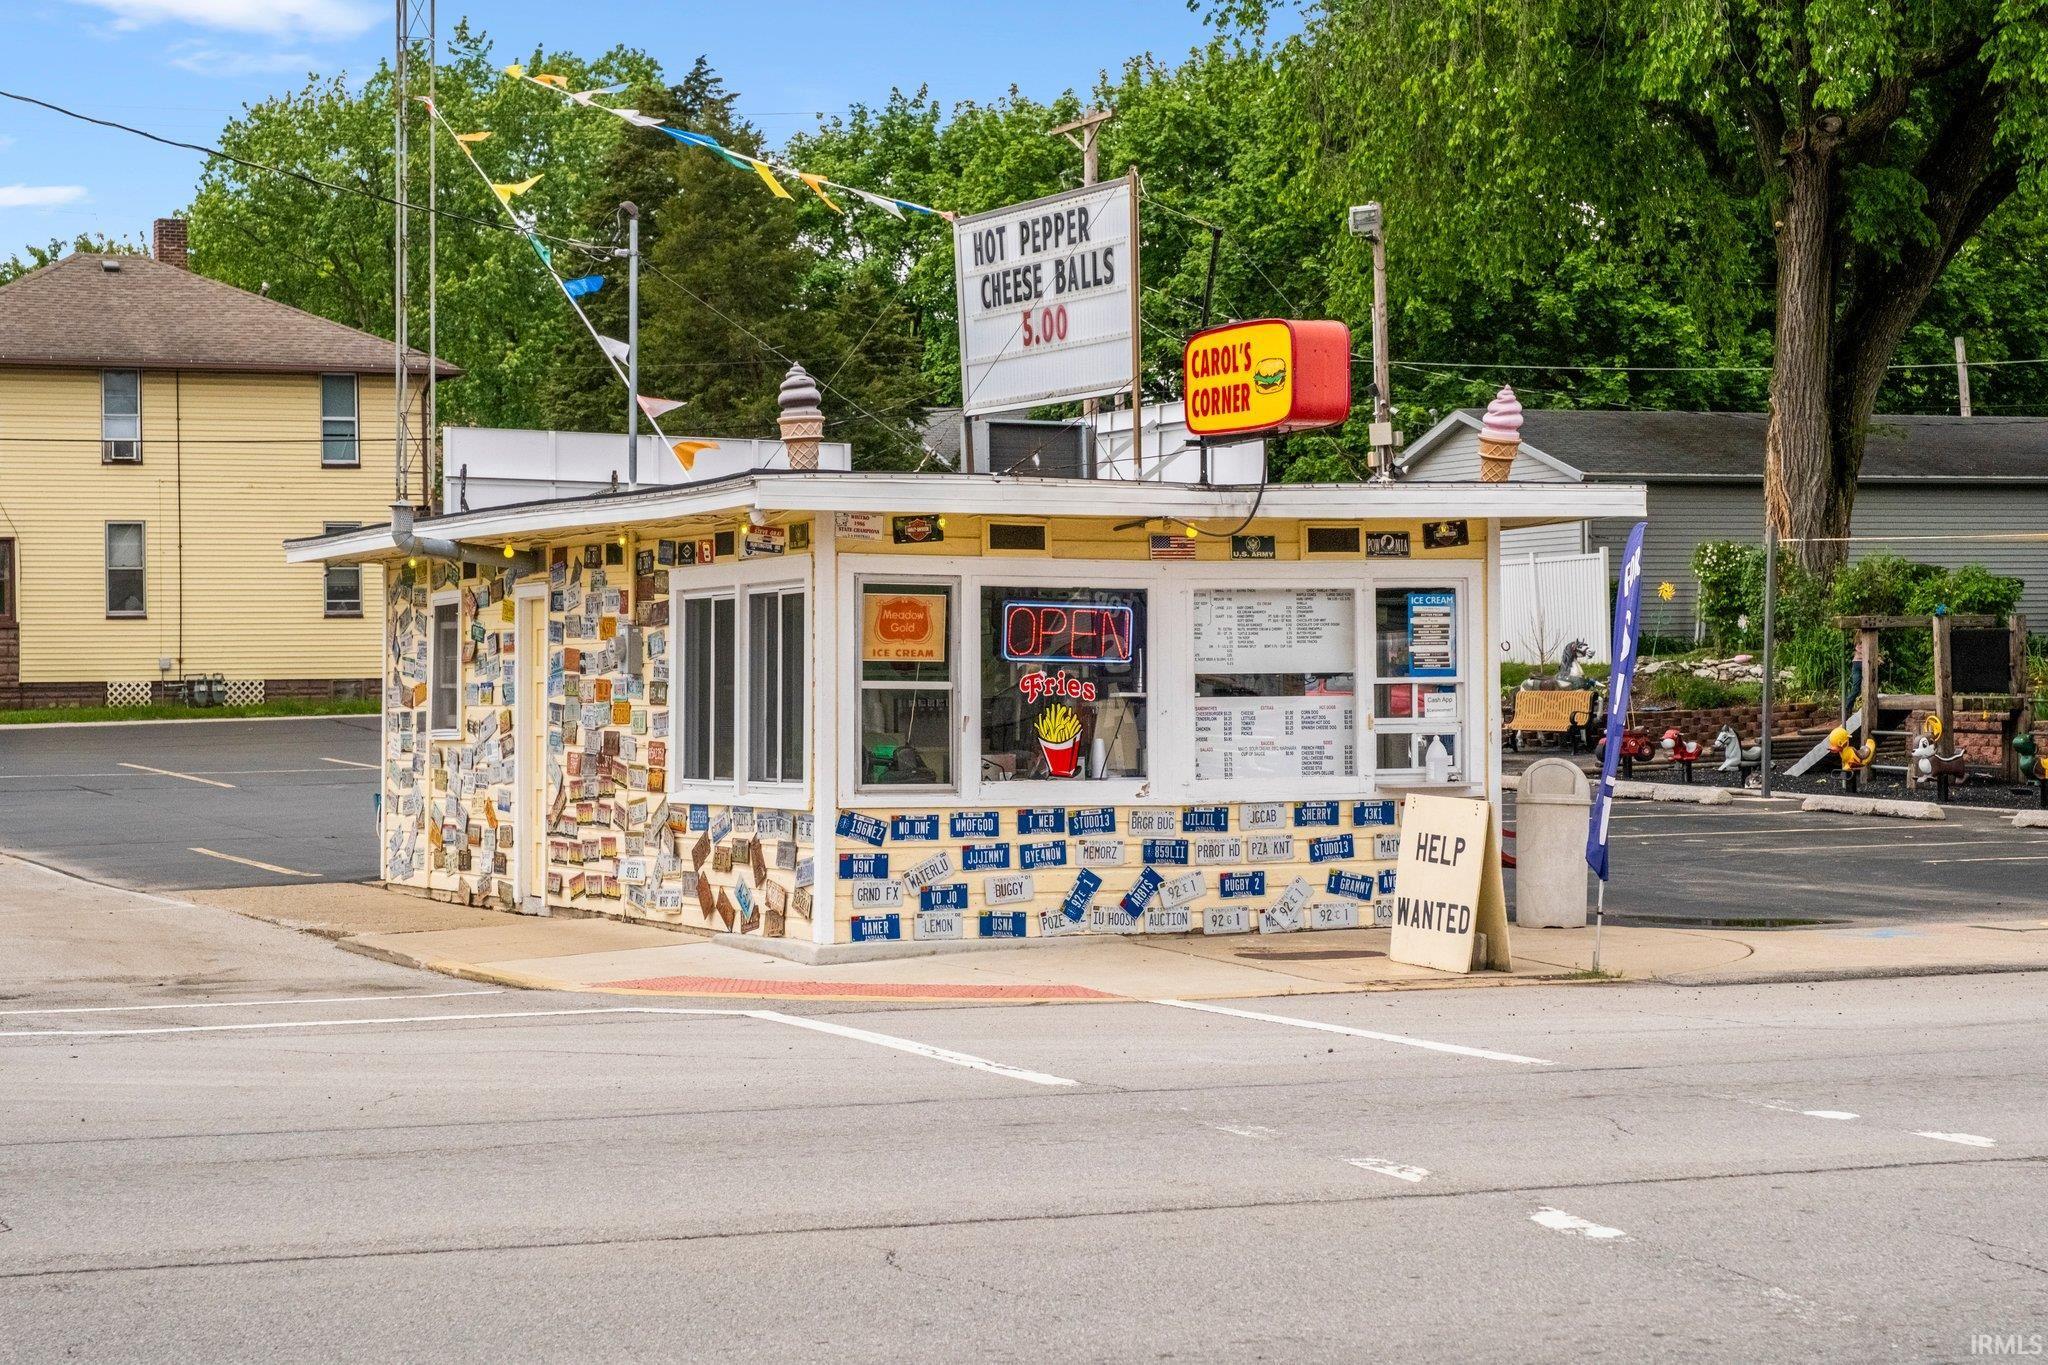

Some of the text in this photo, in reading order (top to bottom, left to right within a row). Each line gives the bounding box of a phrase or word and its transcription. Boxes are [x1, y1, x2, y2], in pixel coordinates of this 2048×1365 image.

[973, 206, 1090, 266] HOT PEPPER
[981, 247, 1114, 309] CHEESE BALLS
[1023, 304, 1068, 347] 5.00
[1192, 341, 1252, 378] CAROL'S
[1192, 383, 1250, 418] CORNER
[1368, 538, 1408, 552] POW MIA
[1251, 551, 1274, 559] ARMY
[882, 609, 924, 620] Meadow
[890, 622, 915, 632] Gold
[1008, 607, 1130, 659] OPEN
[895, 649, 934, 657] CREAM
[1019, 670, 1096, 704] Fries
[1221, 814, 1225, 826] 1
[1301, 808, 1332, 820] SHERRY
[899, 822, 930, 834] NO DNF
[1028, 816, 1032, 828] T
[1132, 817, 1174, 830] BRGR BUG
[1198, 844, 1224, 858] PRROT
[1252, 841, 1290, 855] PZA KNT
[1416, 832, 1466, 866] HELP
[908, 858, 949, 888] WATERLU
[995, 882, 1023, 898] BUGGY
[1225, 878, 1259, 892] RUGBY 2
[1340, 878, 1370, 895] GRAMMY
[858, 886, 898, 901] GRND FX
[1130, 879, 1154, 907] ARBYS
[1093, 911, 1104, 925] IU
[1149, 912, 1188, 926] AUCTION
[1236, 914, 1240, 925] 1
[1344, 909, 1348, 920] 1
[1397, 896, 1470, 934] WANTED
[862, 921, 889, 935] HAMER
[925, 919, 953, 933] LEMON
[992, 918, 1013, 931] USNA
[1042, 914, 1065, 930] POZE
